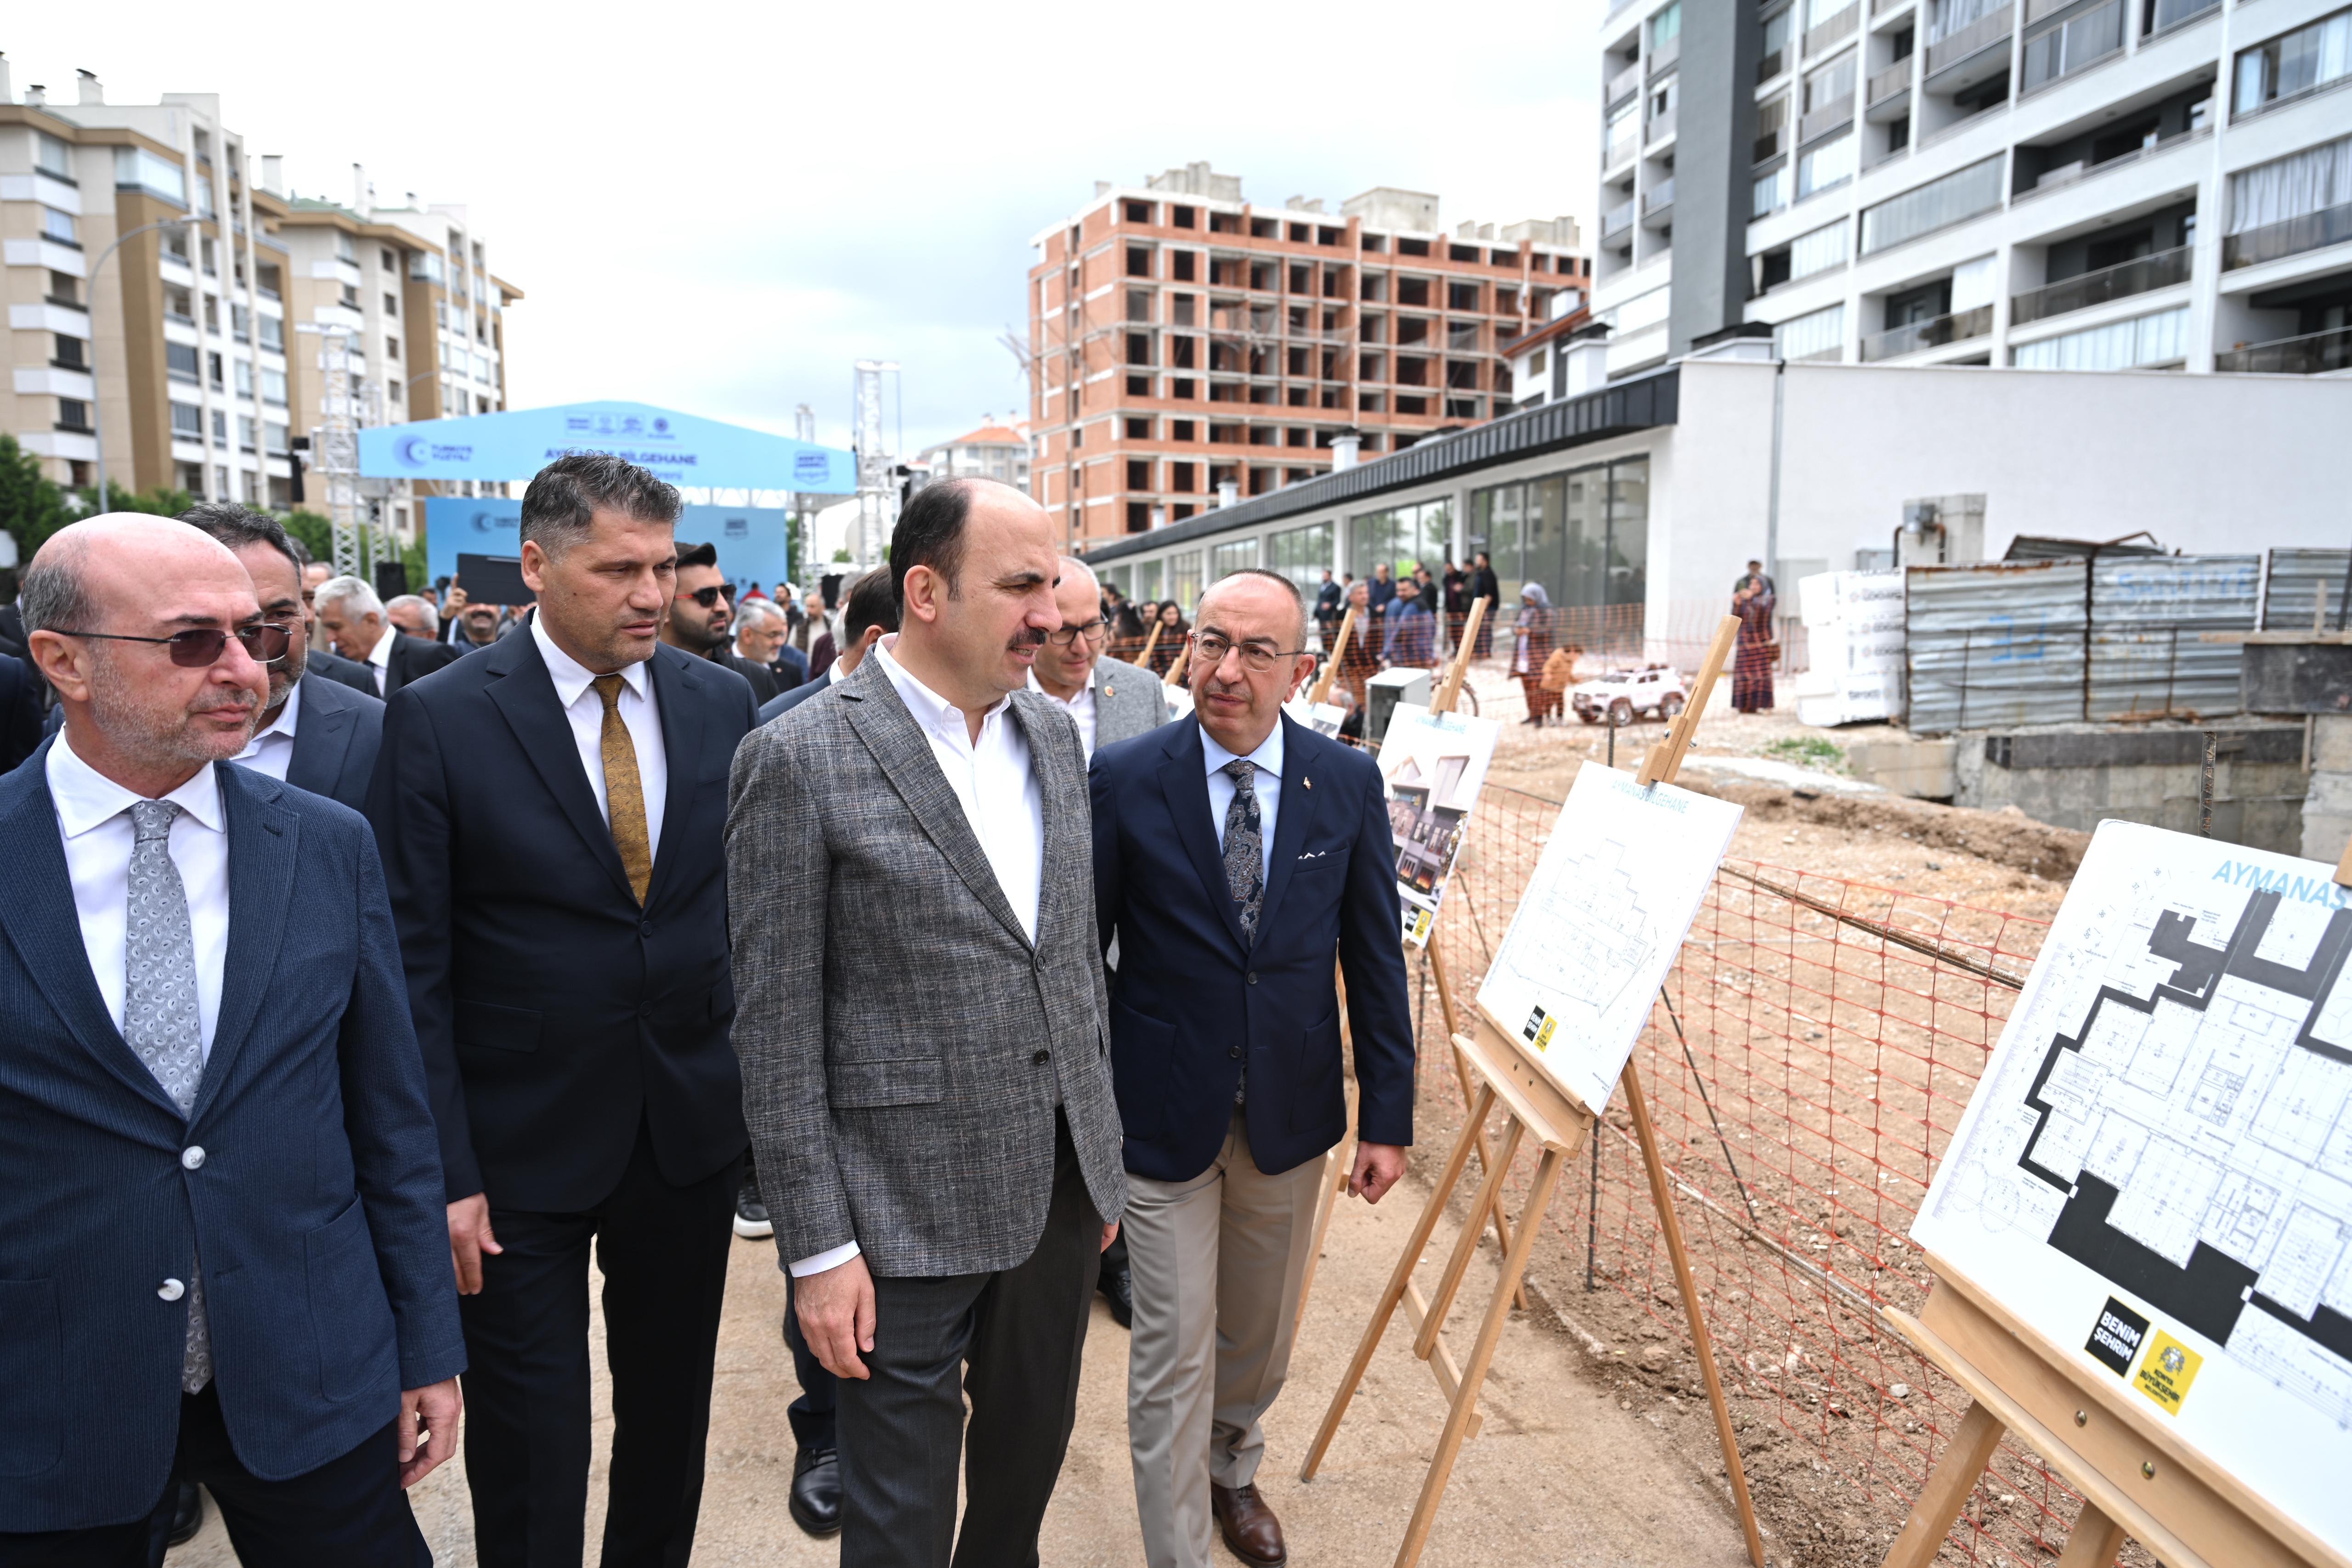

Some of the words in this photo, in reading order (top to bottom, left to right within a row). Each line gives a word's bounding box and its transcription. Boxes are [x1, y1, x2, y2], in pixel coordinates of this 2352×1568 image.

[1611, 779, 1647, 801] AYMANAS
[2211, 860, 2346, 911] AYMANAS
[2093, 1326, 2134, 1362] ŞEHRİM
[2100, 1310, 2141, 1348] BENİM
